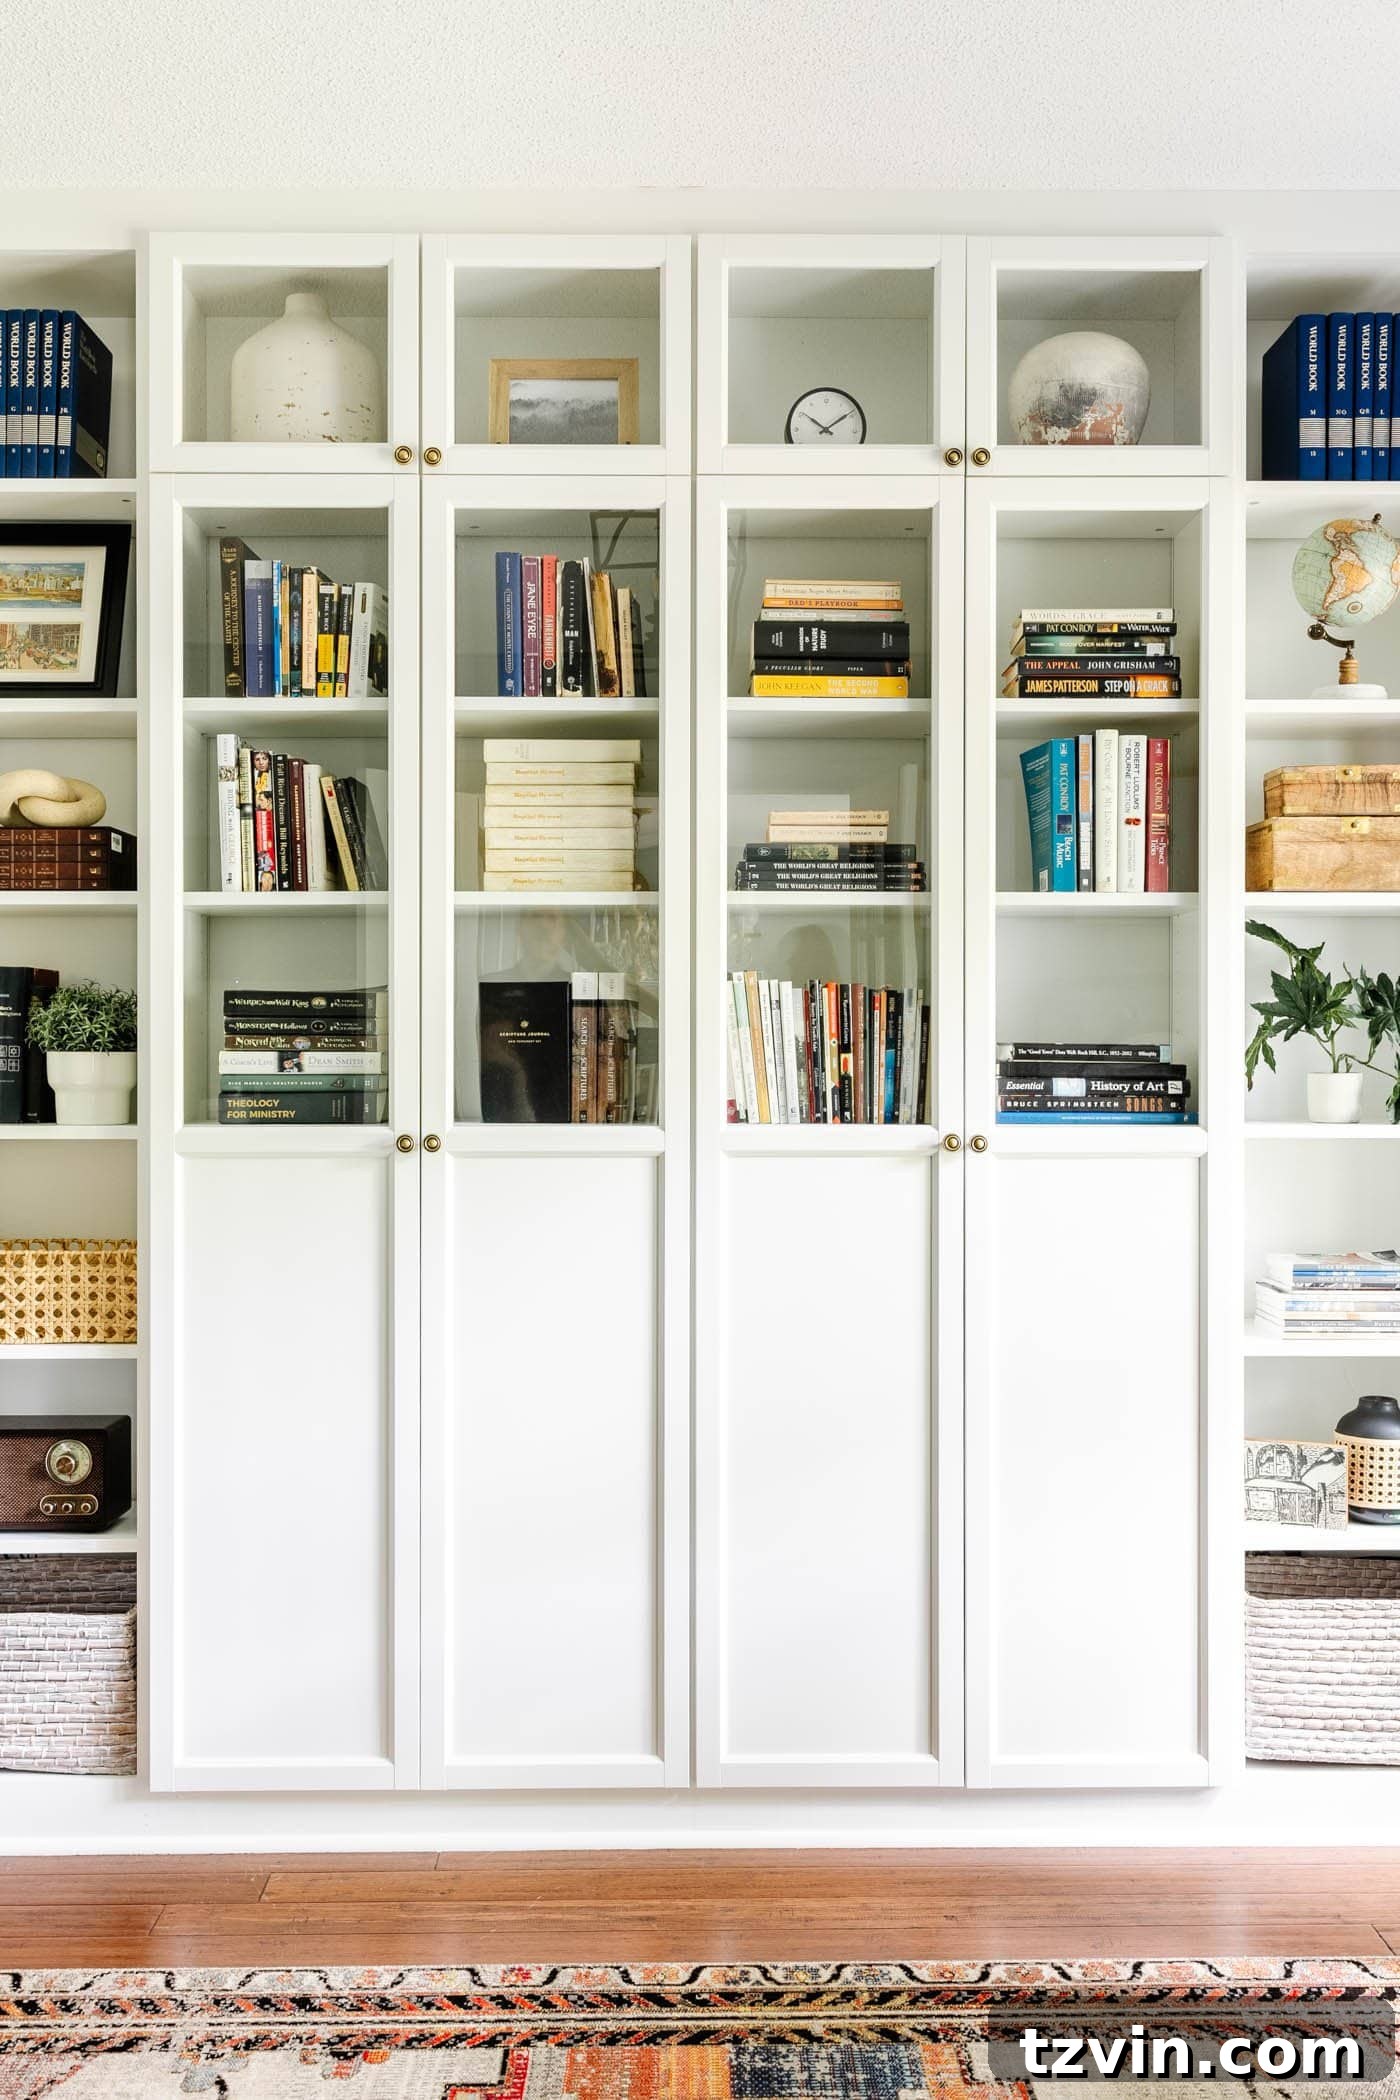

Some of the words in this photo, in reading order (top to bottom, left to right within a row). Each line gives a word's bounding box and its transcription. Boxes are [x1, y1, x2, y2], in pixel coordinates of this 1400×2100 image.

[10, 321, 20, 358] WORLD
[27, 321, 36, 358] WORLD
[44, 321, 52, 358] WORLD
[62, 322, 72, 360] WORLD
[1308, 326, 1318, 362] WORLD
[1337, 325, 1346, 361] WORLD
[1362, 324, 1370, 360] WORLD
[1378, 325, 1388, 361] WORLD
[10, 360, 20, 388] BOOK
[27, 360, 36, 388] BOOK
[44, 360, 52, 388] BOOK
[60, 361, 70, 389] BOOK
[1308, 364, 1318, 392] BOOK
[1337, 363, 1346, 390] BOOK
[1362, 362, 1370, 390] BOOK
[1378, 363, 1388, 390] BOOK
[224, 592, 230, 602] OF
[230, 576, 238, 610] JOURNEY
[526, 582, 536, 608] JANE
[232, 611, 238, 619] TO
[528, 612, 536, 638] EYRE
[1046, 624, 1060, 633] PAT
[1060, 624, 1094, 633] CONROY
[543, 614, 554, 658] FAHRENHEIT
[811, 627, 819, 652] NATURE
[820, 628, 828, 650] STUDY
[232, 637, 240, 666] CENTER
[1024, 661, 1044, 670] THE
[1046, 661, 1080, 670] APPEAL
[1087, 662, 1112, 670] JOHN
[1113, 662, 1156, 670] GRISHAM
[758, 682, 782, 690] JOHN
[784, 682, 823, 691] KEEGAN
[1024, 680, 1052, 693] JAMES
[1053, 680, 1098, 693] PATTERSON
[1104, 680, 1123, 692] STEP
[1123, 680, 1135, 692] ON
[276, 763, 284, 776] Fall
[1060, 762, 1068, 776] PAT
[1154, 762, 1164, 776] PAT
[1060, 776, 1068, 810] CONROY
[1154, 776, 1163, 810] CONROY
[278, 798, 286, 825] Dreams
[280, 842, 288, 874] Reynolds
[1056, 842, 1064, 868] MUSIC
[1064, 836, 1073, 860] BEACH
[776, 882, 790, 890] THE
[790, 882, 818, 890] WORLD'S
[819, 882, 840, 890] GREAT
[841, 882, 876, 890] RELIGIONS
[292, 999, 310, 1008] King
[580, 1017, 588, 1046] SEARCH
[607, 1018, 616, 1046] SEARCH
[580, 1056, 588, 1101] SCRIPTURES
[607, 1057, 616, 1102] SCRIPTURES
[1006, 1081, 1044, 1090] Essential
[1091, 1082, 1131, 1093] History
[1133, 1082, 1144, 1091] of
[1146, 1082, 1164, 1091] Art
[227, 1099, 280, 1108] THEOLOGY
[227, 1110, 246, 1118] FOR
[249, 1110, 296, 1118] MINISTRY
[1006, 1100, 1038, 1108] BRUCE
[1047, 1100, 1119, 1108] SPRINGSTEEN
[1126, 1098, 1163, 1112] SONGS
